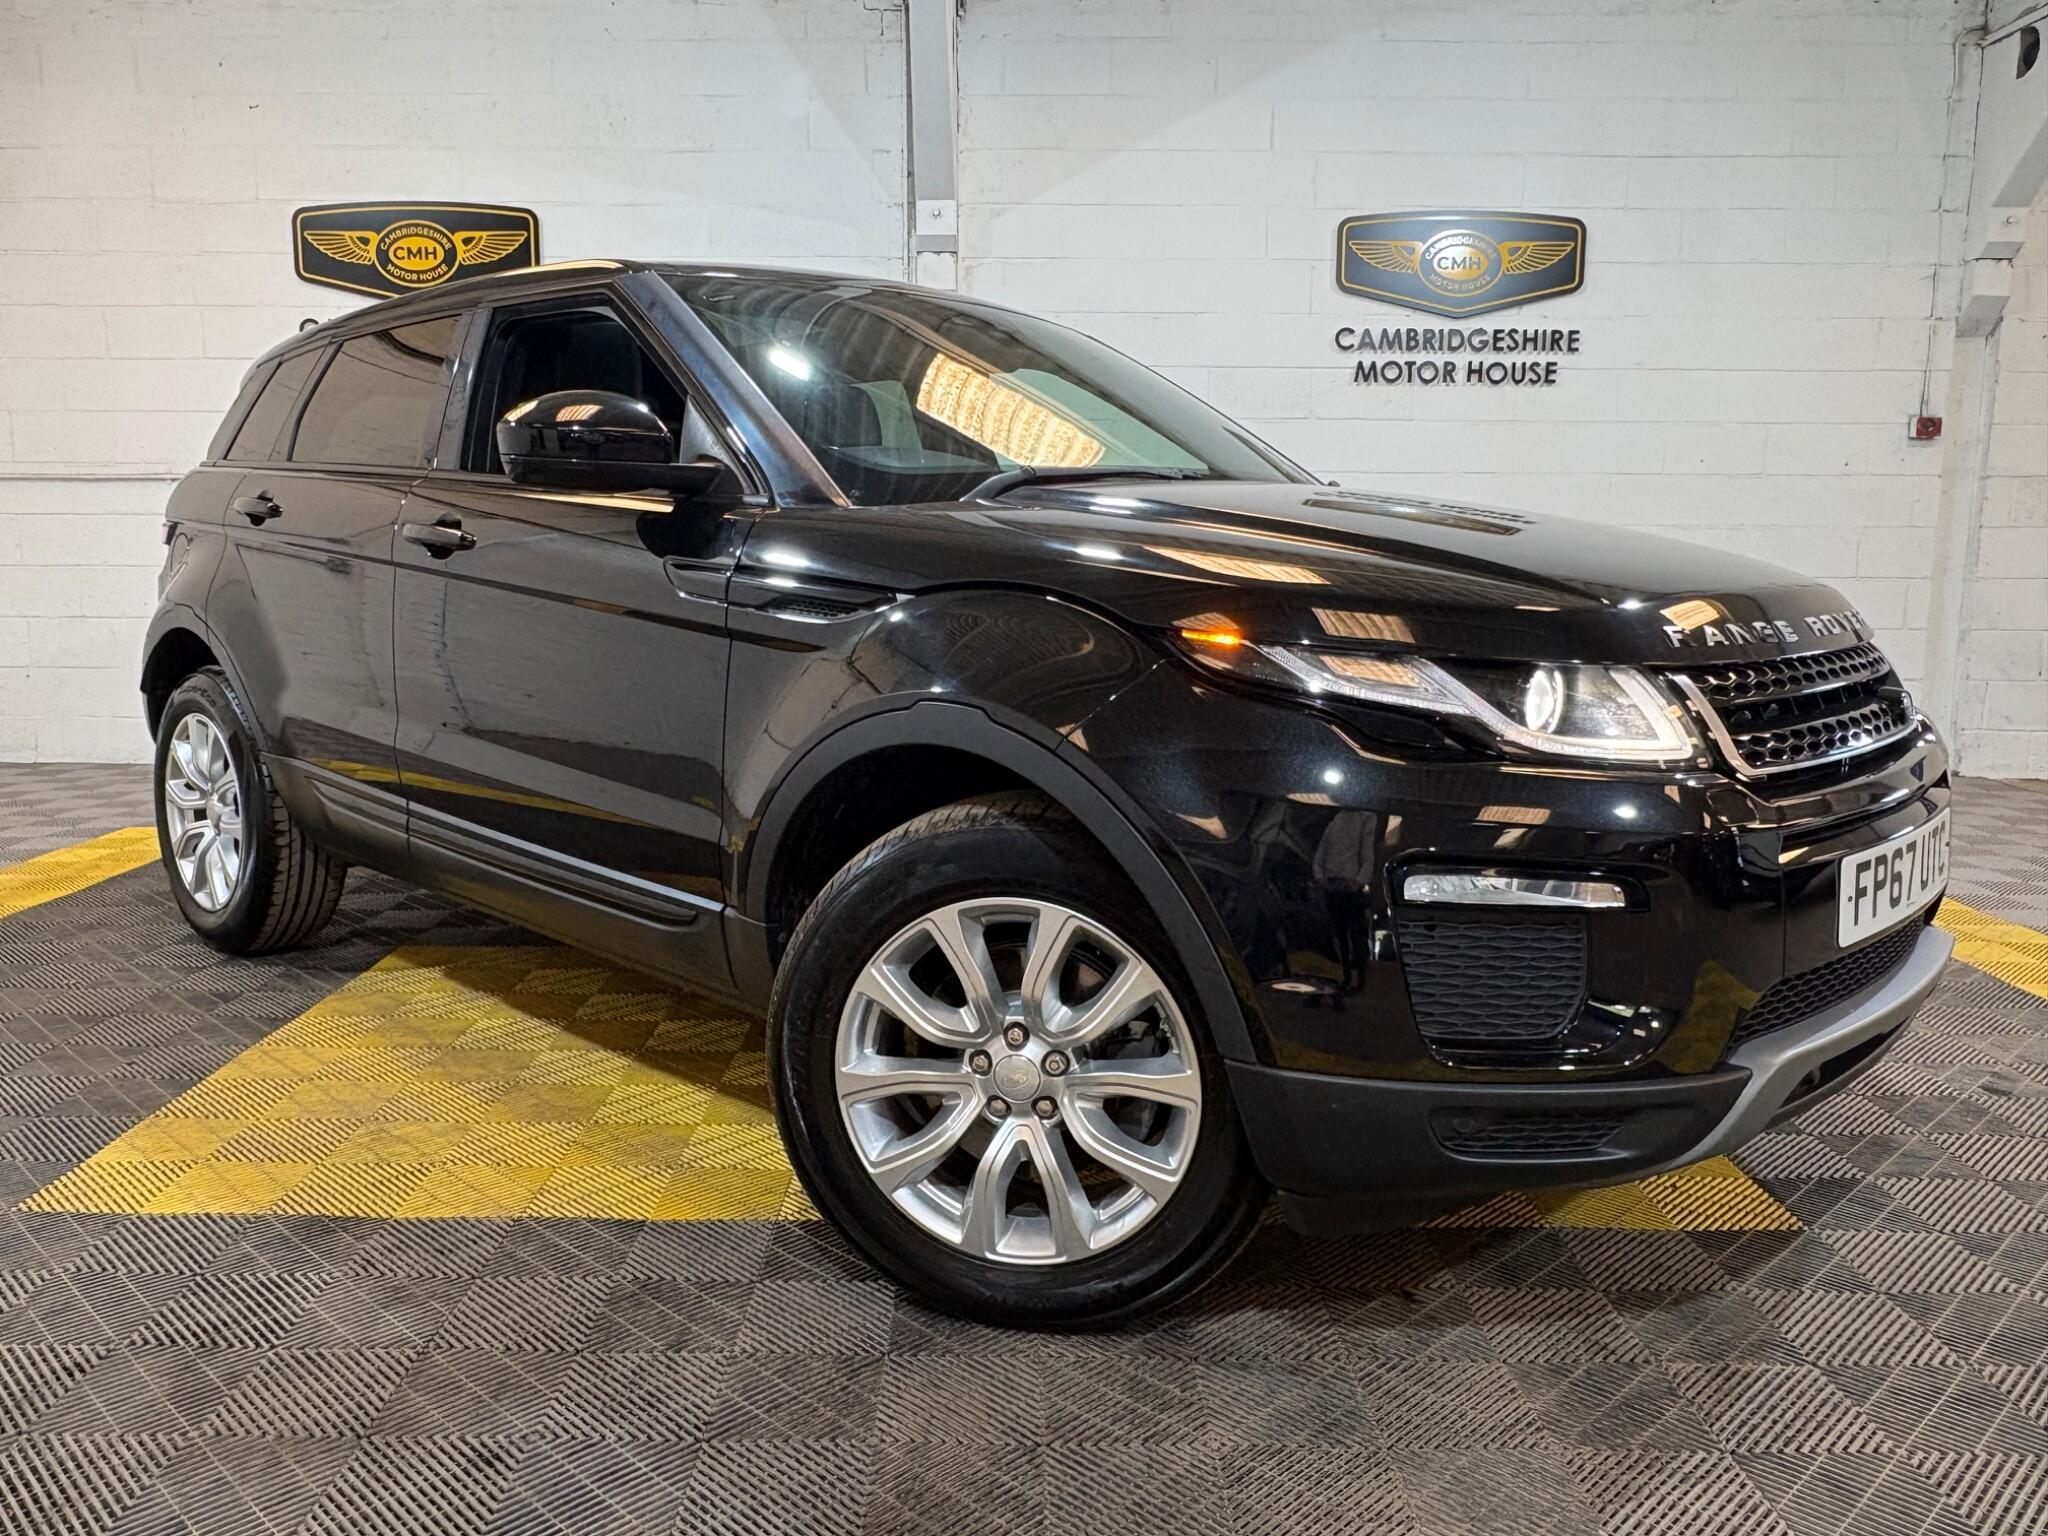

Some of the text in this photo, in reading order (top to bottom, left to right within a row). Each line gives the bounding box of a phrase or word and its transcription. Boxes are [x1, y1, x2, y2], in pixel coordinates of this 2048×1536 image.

[381, 227, 452, 250] CAMBRIDGESHIRE
[393, 246, 437, 260] CMH
[1437, 256, 1481, 270] CMH
[387, 263, 449, 280] MOTOR HOUSE
[1335, 327, 1581, 352] CAMBRIDGESHIRE
[1354, 361, 1558, 385] MOTOR HOUSE
[1854, 820, 1946, 927] FP67 UTC
